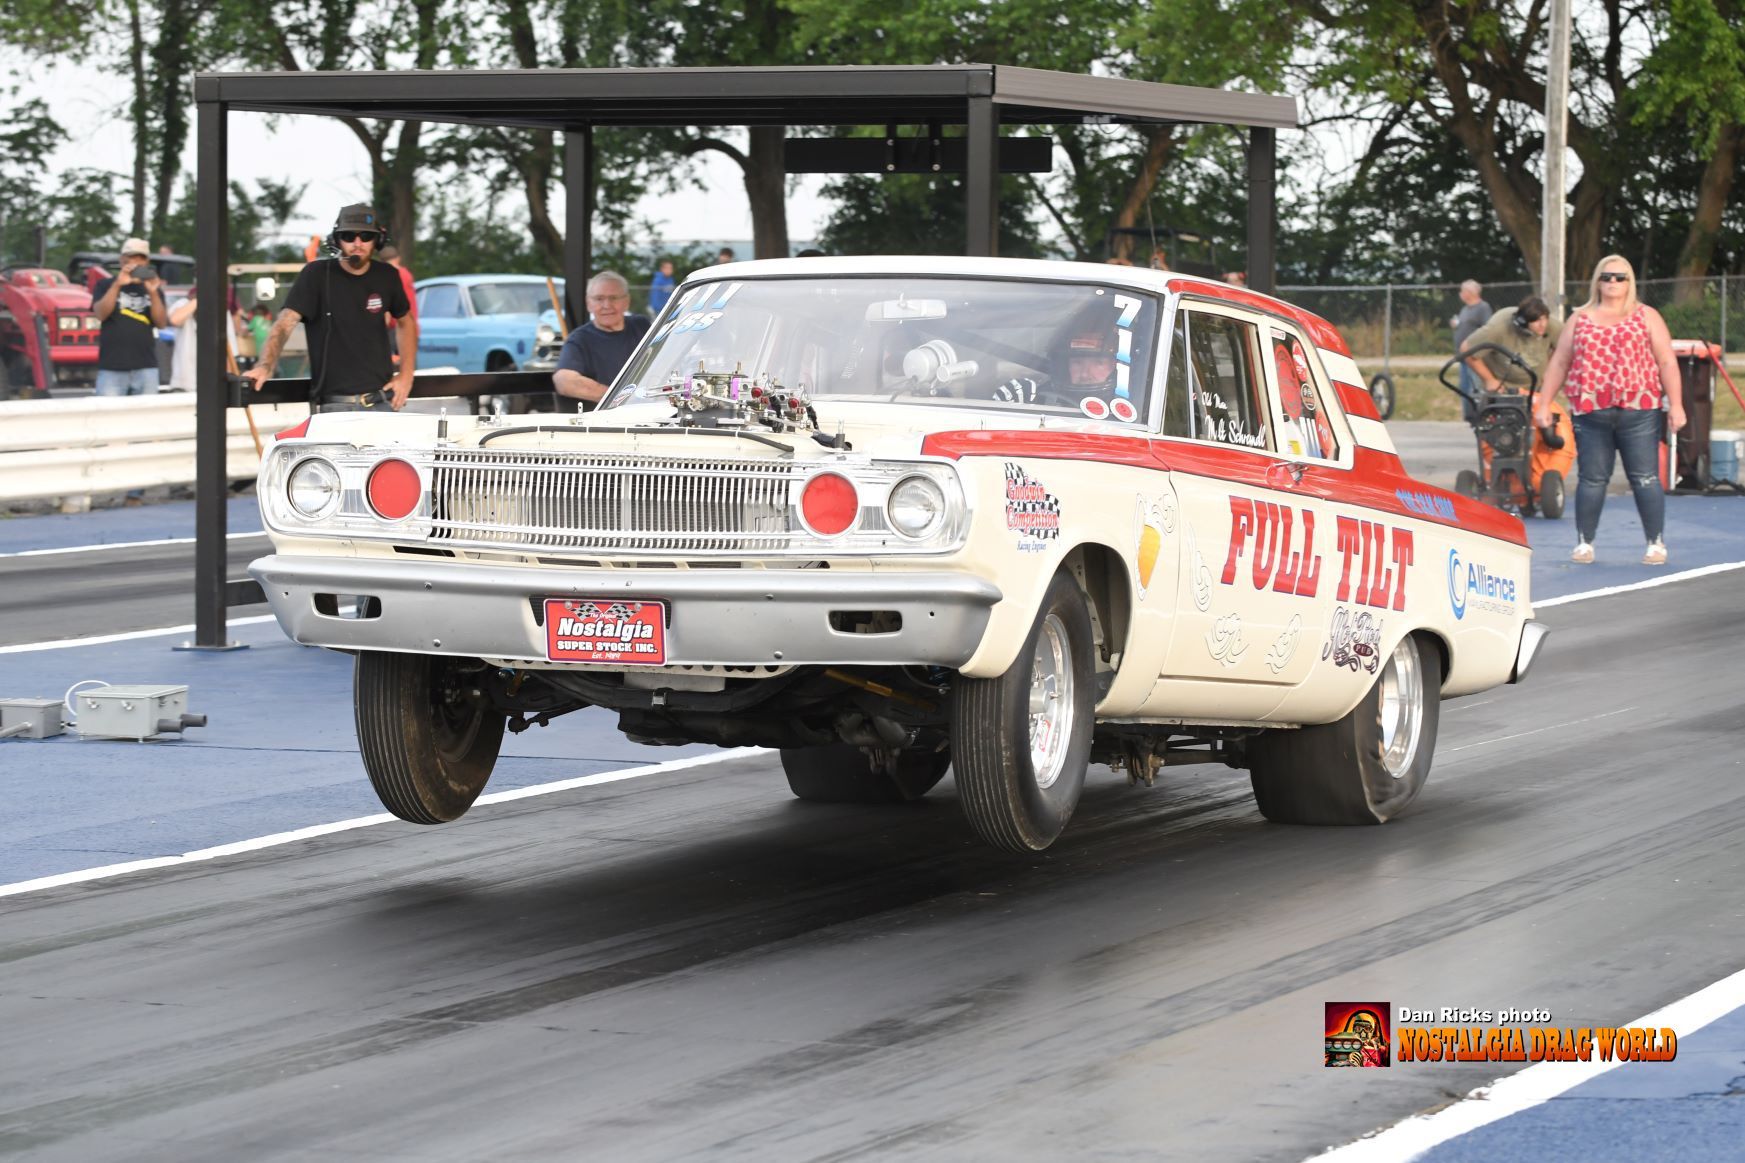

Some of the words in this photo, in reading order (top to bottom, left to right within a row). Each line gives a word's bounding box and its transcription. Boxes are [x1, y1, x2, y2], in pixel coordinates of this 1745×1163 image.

[1007, 475, 1046, 503] Goodwin
[1007, 504, 1061, 537] Competition
[1220, 494, 1321, 598] FULL
[1336, 514, 1414, 612] TILT
[1467, 562, 1515, 602] Alliance
[557, 618, 654, 641] Nostalgia
[557, 640, 593, 651] SUPER
[596, 642, 632, 653] STOCK
[635, 643, 658, 653] INC.
[1355, 644, 1372, 656] PUB
